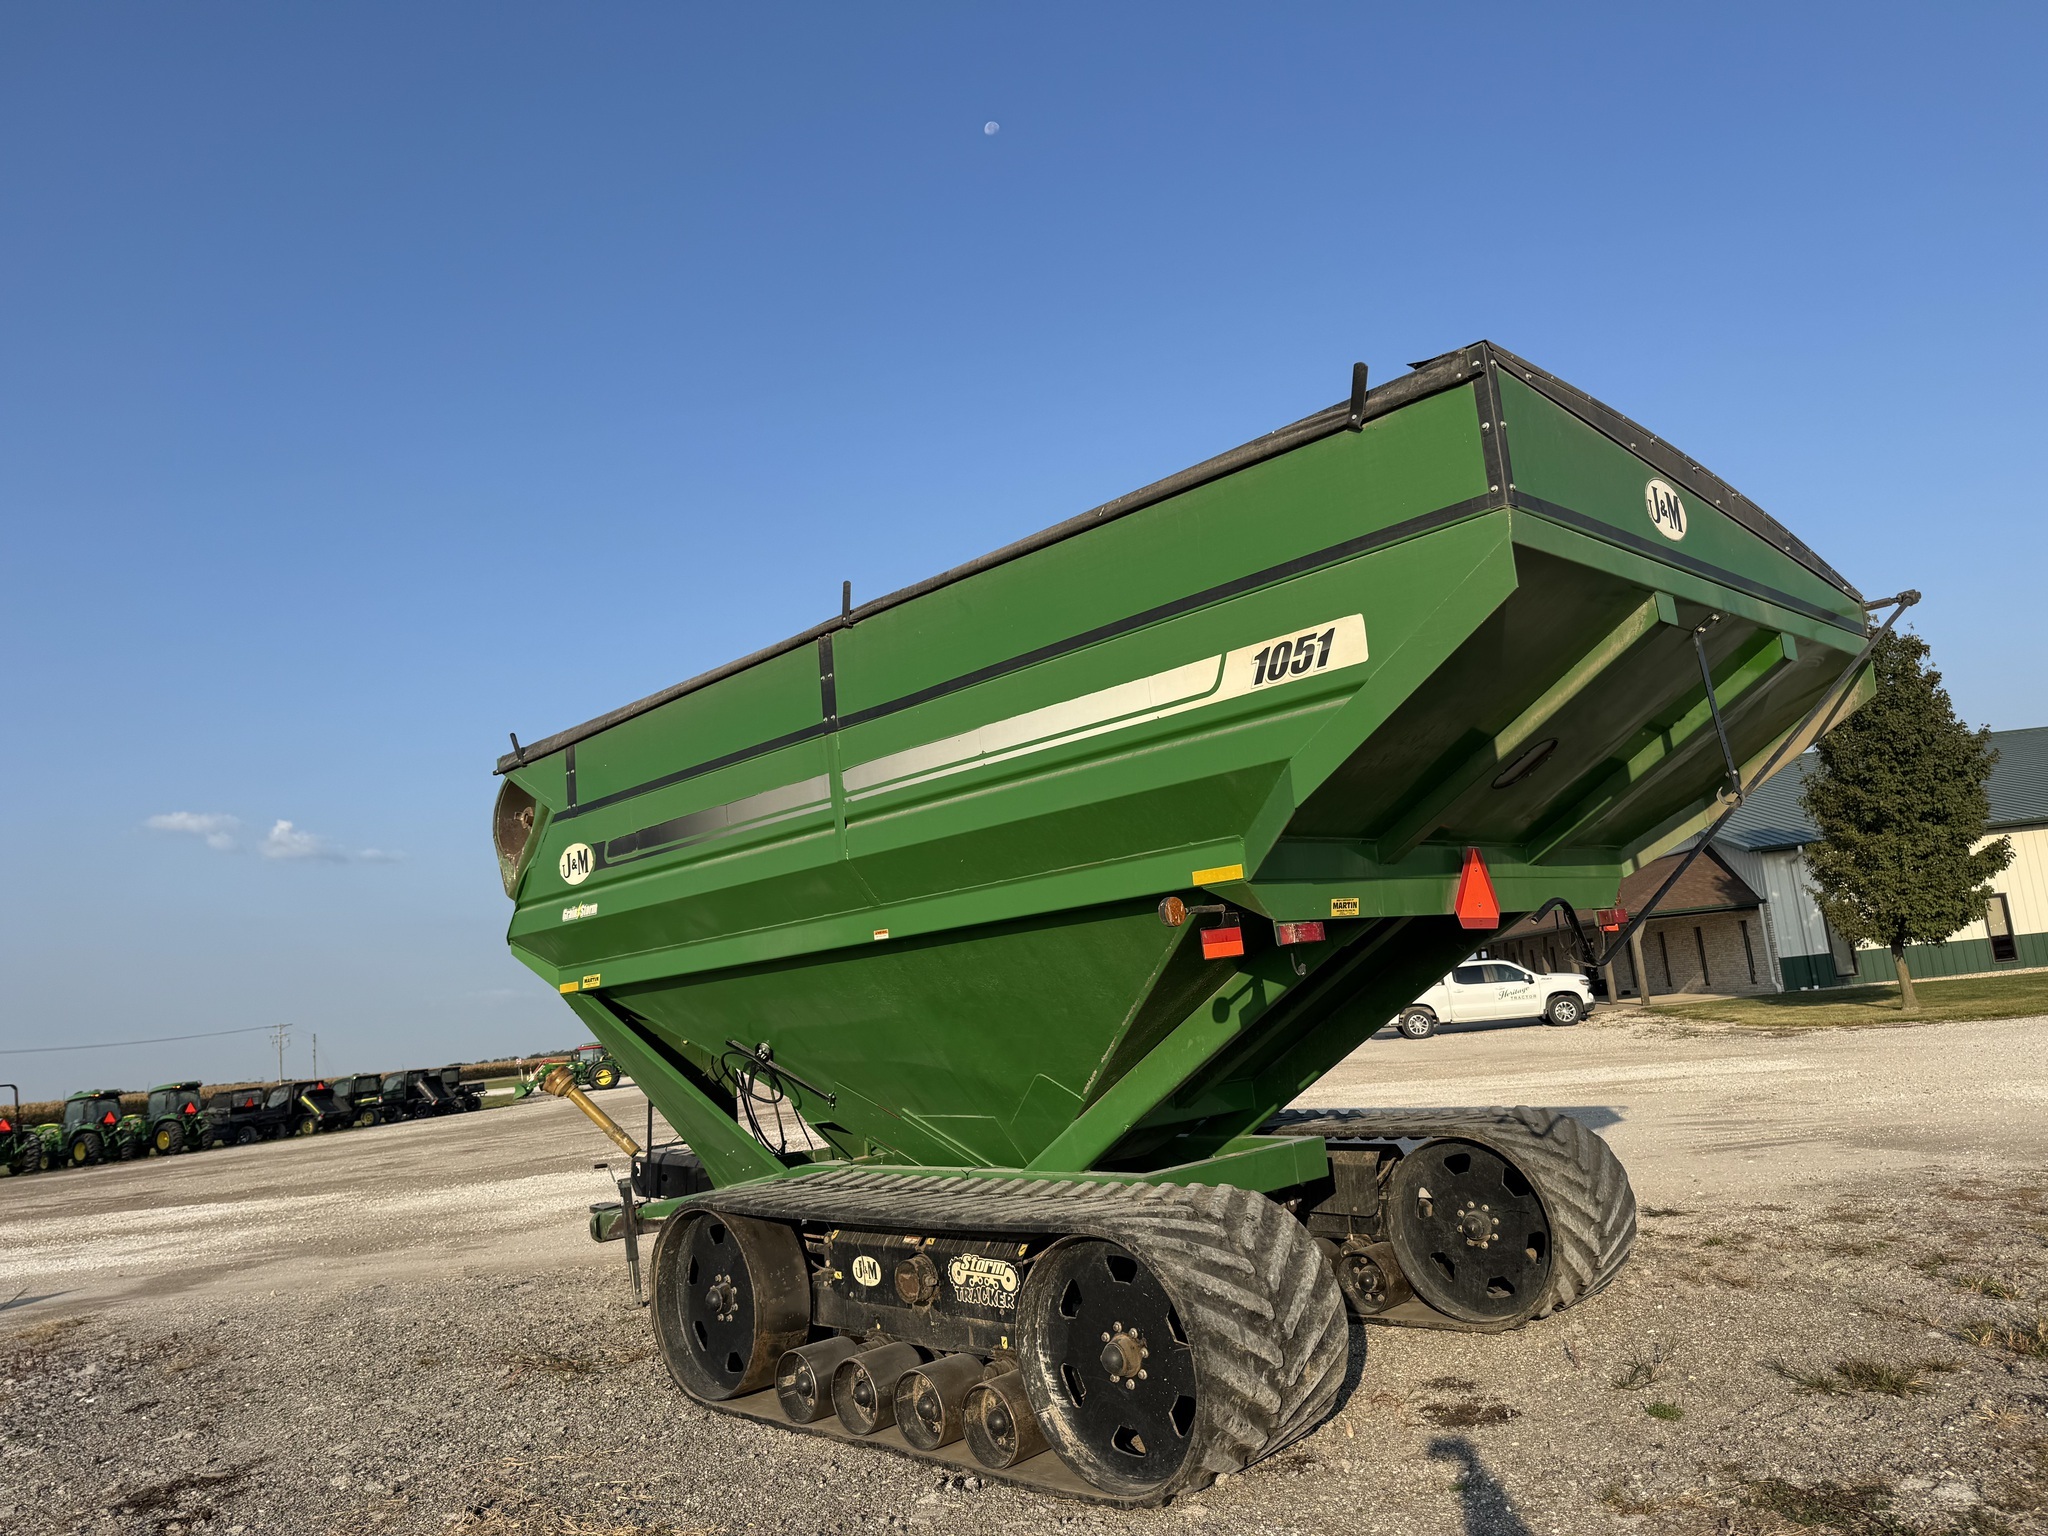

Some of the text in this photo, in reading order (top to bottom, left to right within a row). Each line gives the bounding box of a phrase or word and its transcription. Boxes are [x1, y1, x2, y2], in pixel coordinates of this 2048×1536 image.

[1648, 486, 1684, 533] J&M
[1253, 627, 1335, 686] 1051
[562, 848, 589, 878] J&M
[1498, 986, 1530, 1000] Heritage
[855, 1260, 878, 1280] J&M
[960, 1255, 1006, 1275] Storm
[955, 1286, 1014, 1309] TRACKER
